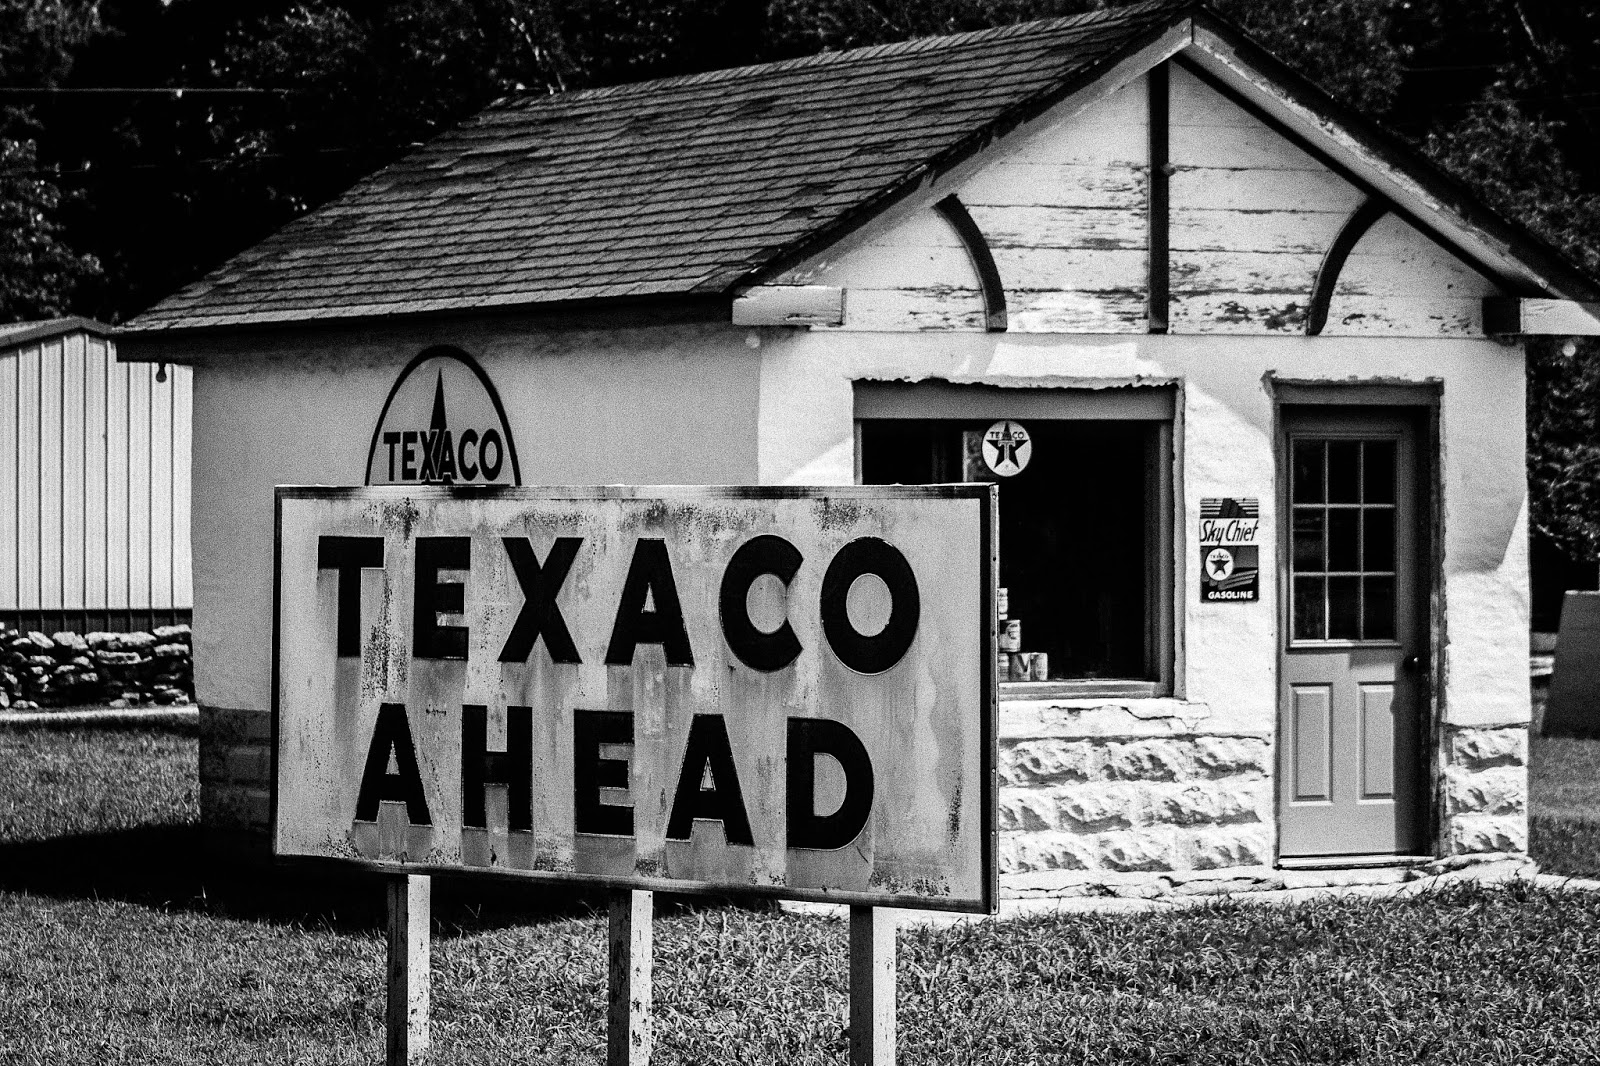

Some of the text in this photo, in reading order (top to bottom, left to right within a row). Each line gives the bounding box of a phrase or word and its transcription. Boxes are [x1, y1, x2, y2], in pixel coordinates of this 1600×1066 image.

[383, 428, 503, 482] TEXACO
[1200, 519, 1259, 547] Sky Chief
[316, 534, 920, 676] TEXACO
[1207, 590, 1254, 600] GASOLINE
[353, 702, 875, 851] AHEAD
